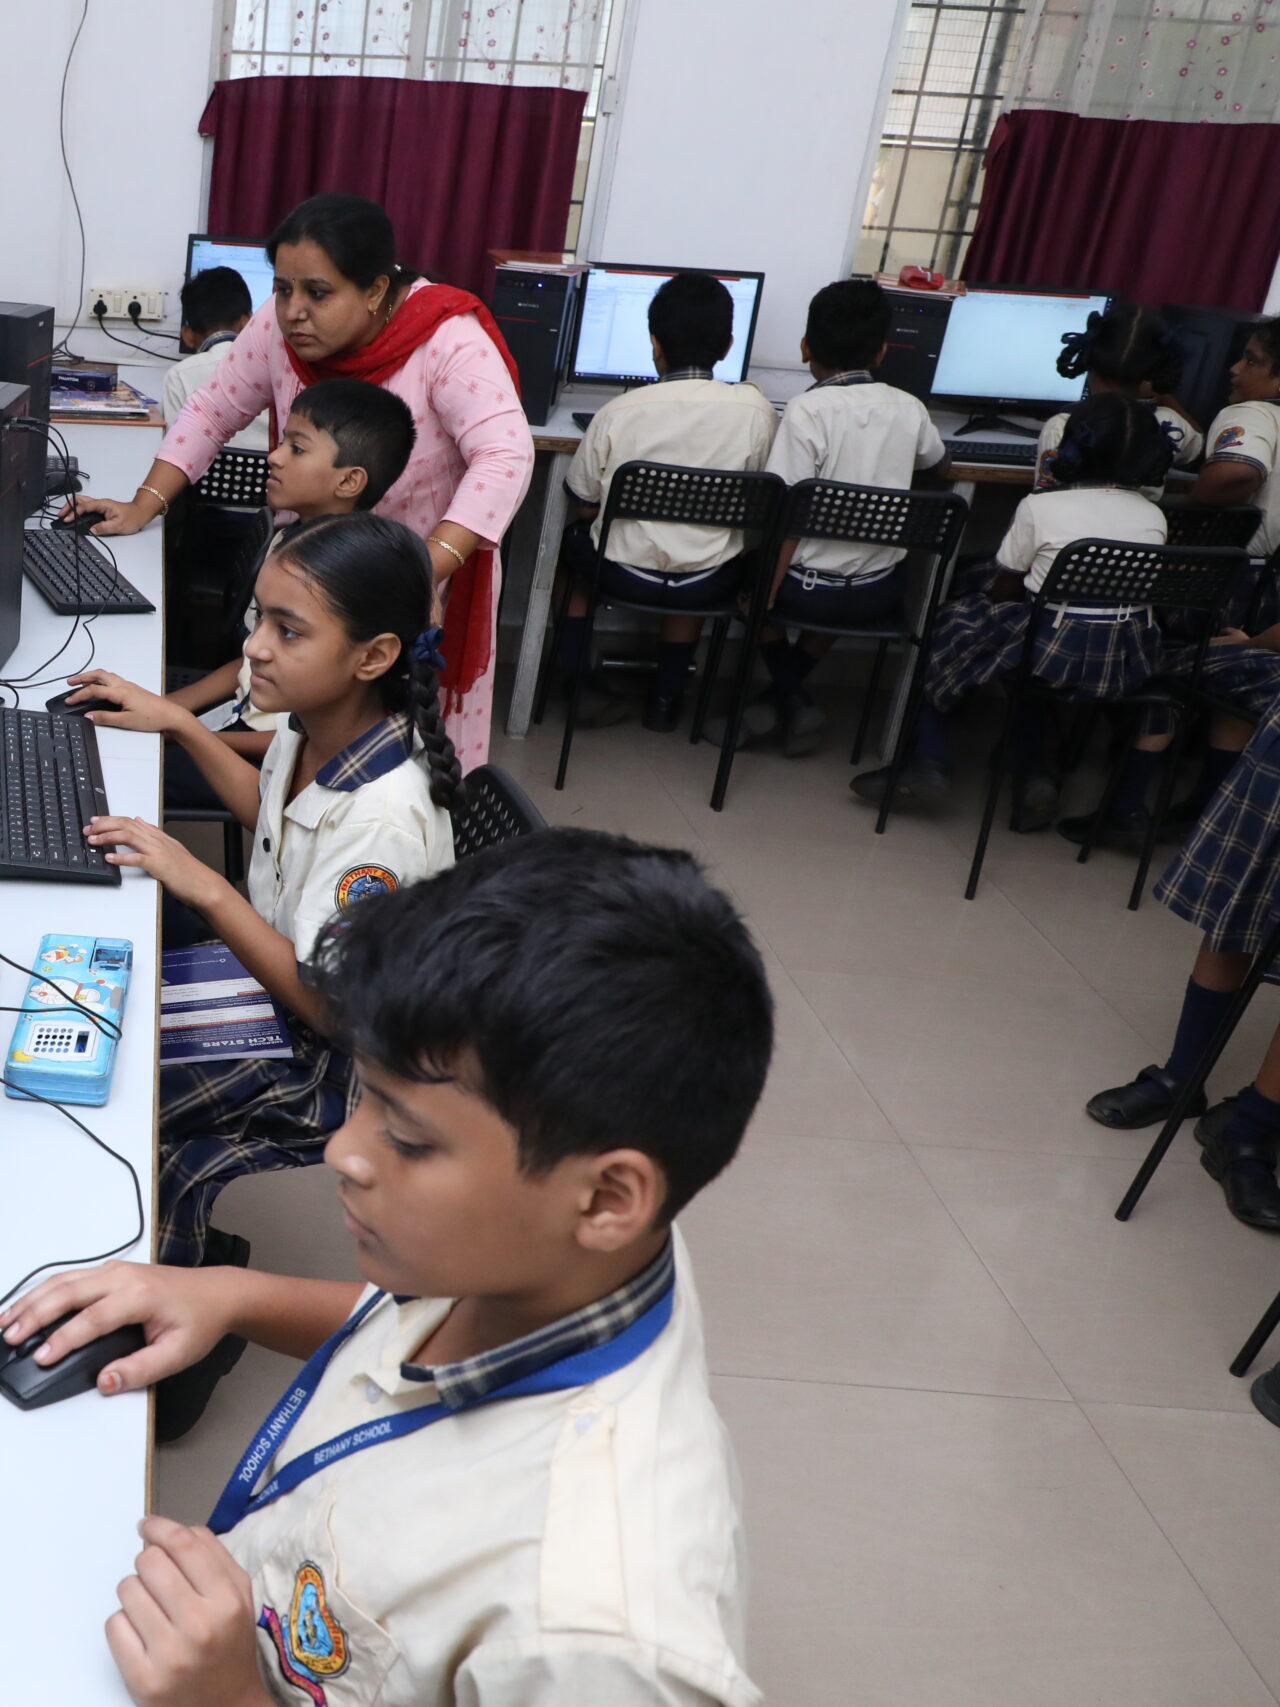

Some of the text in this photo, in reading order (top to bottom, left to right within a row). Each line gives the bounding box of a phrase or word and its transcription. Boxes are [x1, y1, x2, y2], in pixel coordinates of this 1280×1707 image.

[340, 868, 379, 892] BETHANY
[202, 1035, 282, 1048] TECH STARS
[268, 1386, 308, 1442] BETHANY
[238, 1437, 272, 1484] SCHOOL
[313, 1420, 393, 1466] BETHANY SCHOOL
